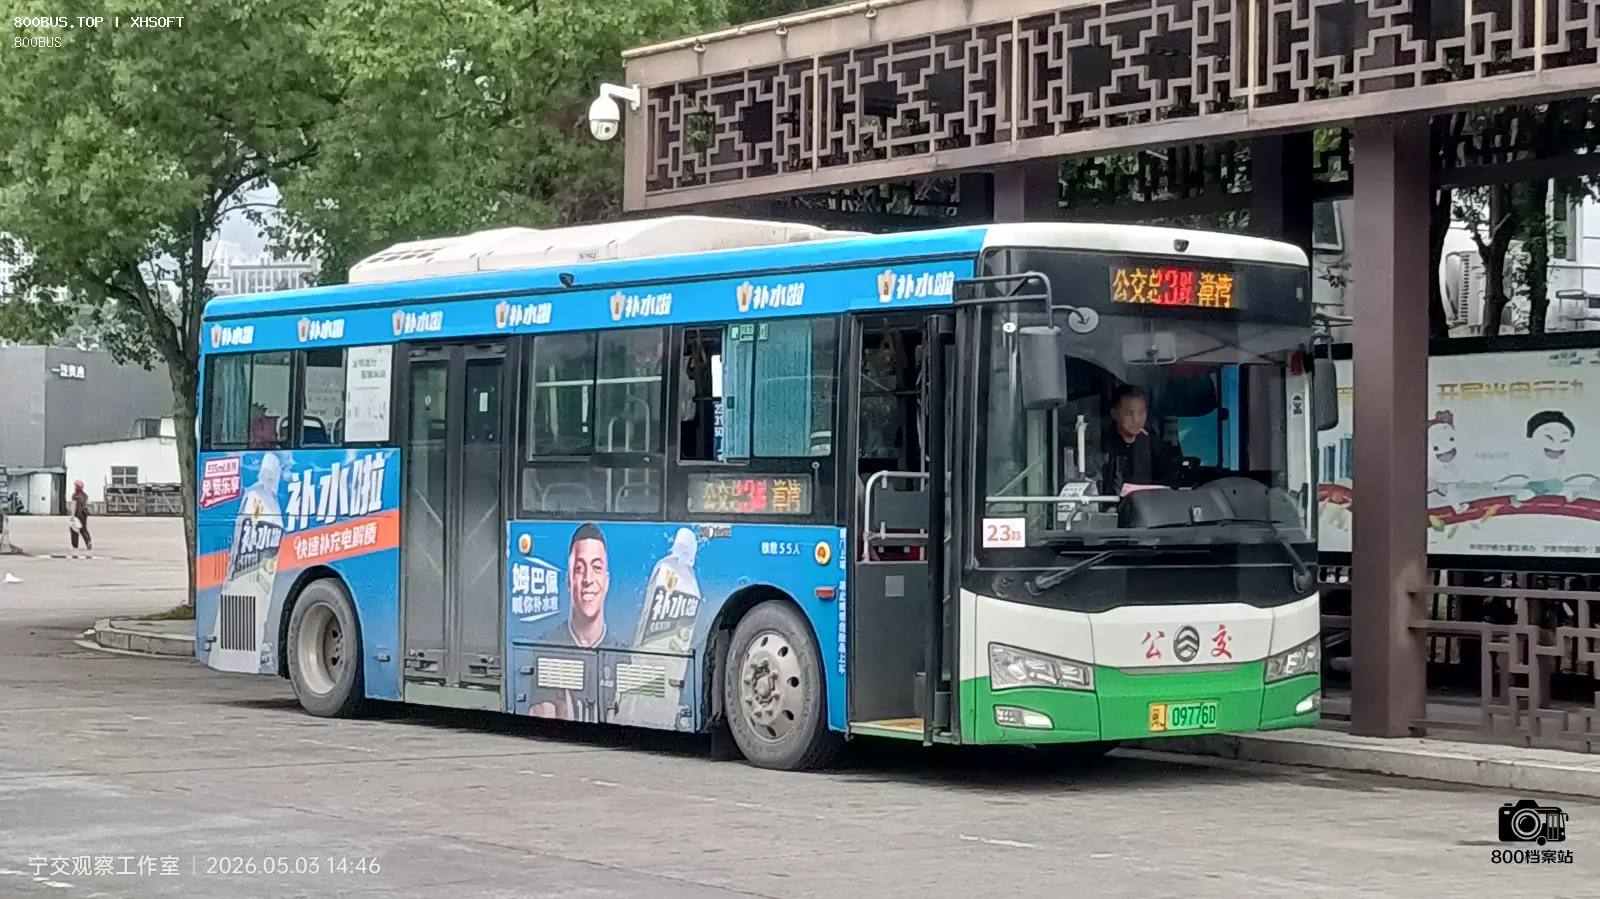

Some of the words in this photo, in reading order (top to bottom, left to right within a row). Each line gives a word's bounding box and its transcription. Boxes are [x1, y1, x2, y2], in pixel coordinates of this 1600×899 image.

[285, 452, 386, 532] 补水啦
[512, 562, 558, 595] 姆巴佩
[1141, 630, 1166, 660] 公
[1211, 624, 1233, 659] 交
[1172, 705, 1216, 726] 09776D
